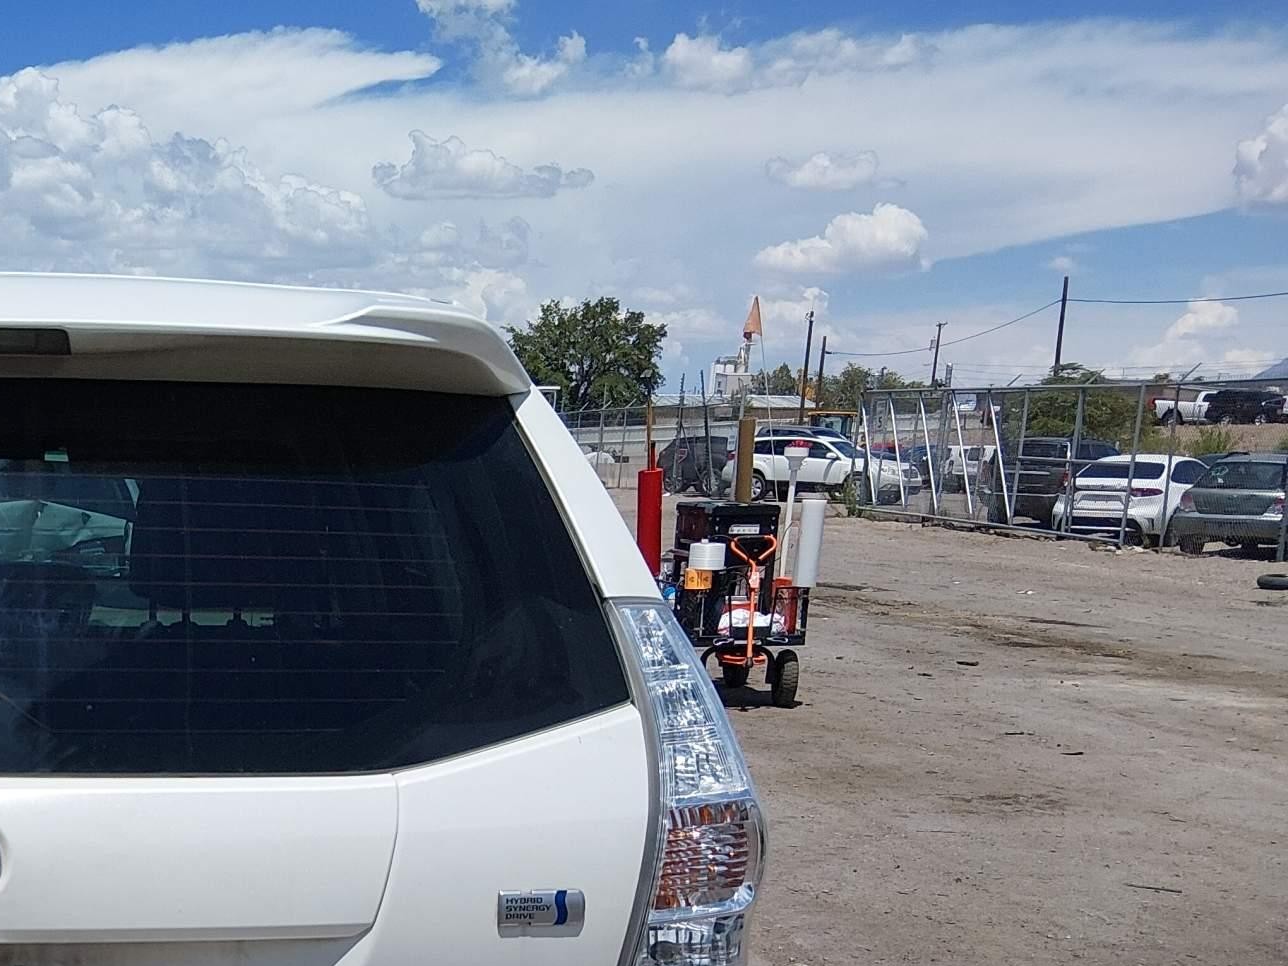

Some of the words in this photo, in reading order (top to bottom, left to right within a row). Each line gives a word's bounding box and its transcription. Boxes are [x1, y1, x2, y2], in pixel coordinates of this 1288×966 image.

[505, 897, 544, 905] HYBRID
[505, 904, 552, 912] SYNERGY
[505, 912, 535, 920] DRIVE
